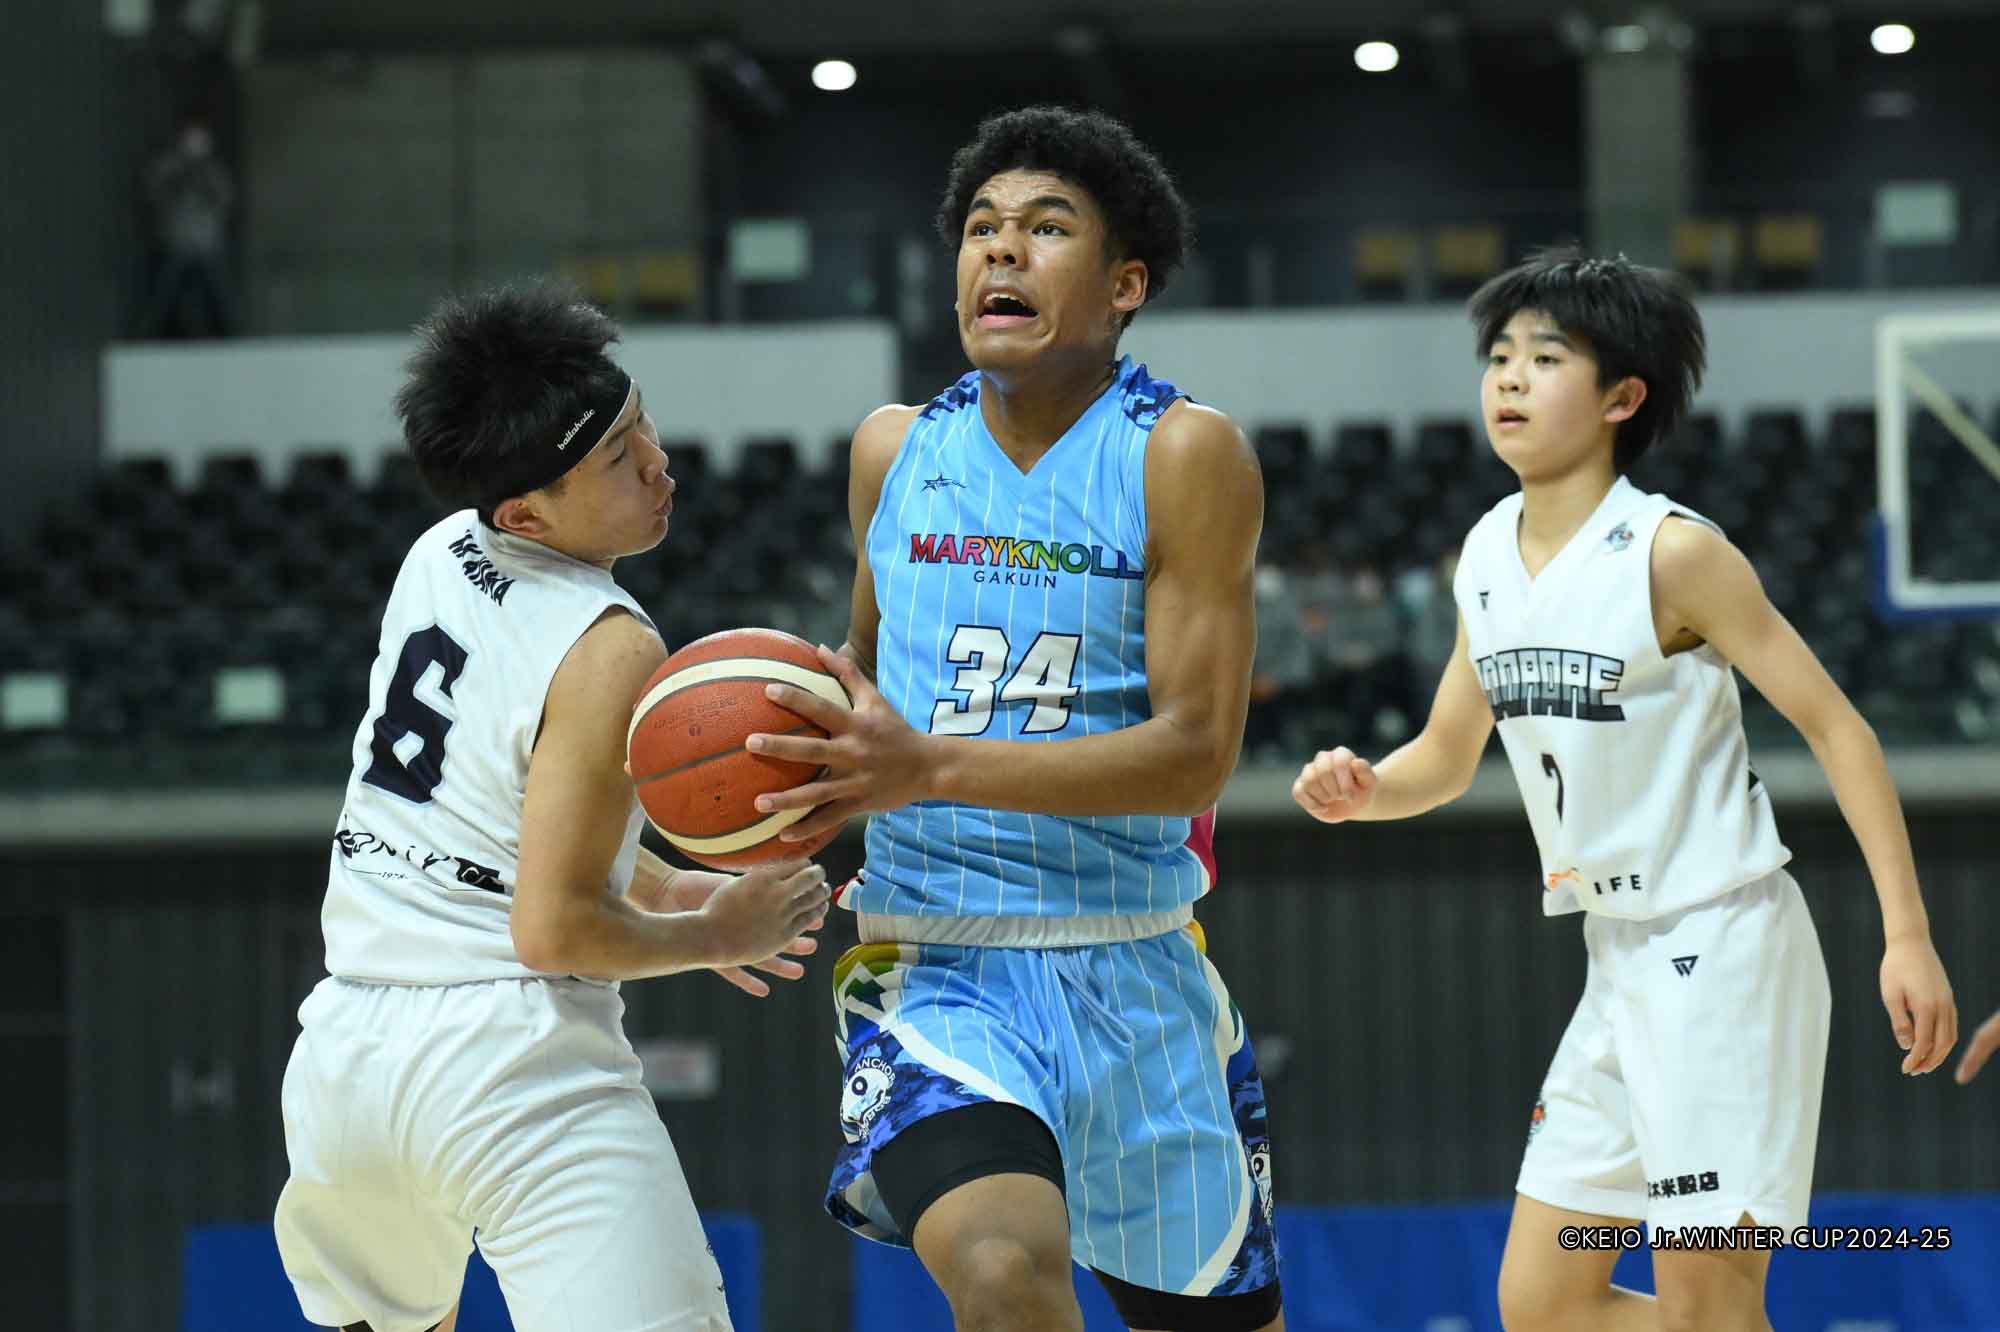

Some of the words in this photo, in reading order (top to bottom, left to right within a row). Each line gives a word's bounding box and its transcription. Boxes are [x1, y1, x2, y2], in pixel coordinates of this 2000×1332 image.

[557, 409, 596, 450] ballaholic
[908, 533, 1145, 580] MARYKNOLL
[973, 570, 1057, 588] GAKUIN
[928, 624, 1082, 736] 34
[361, 623, 469, 804] 6
